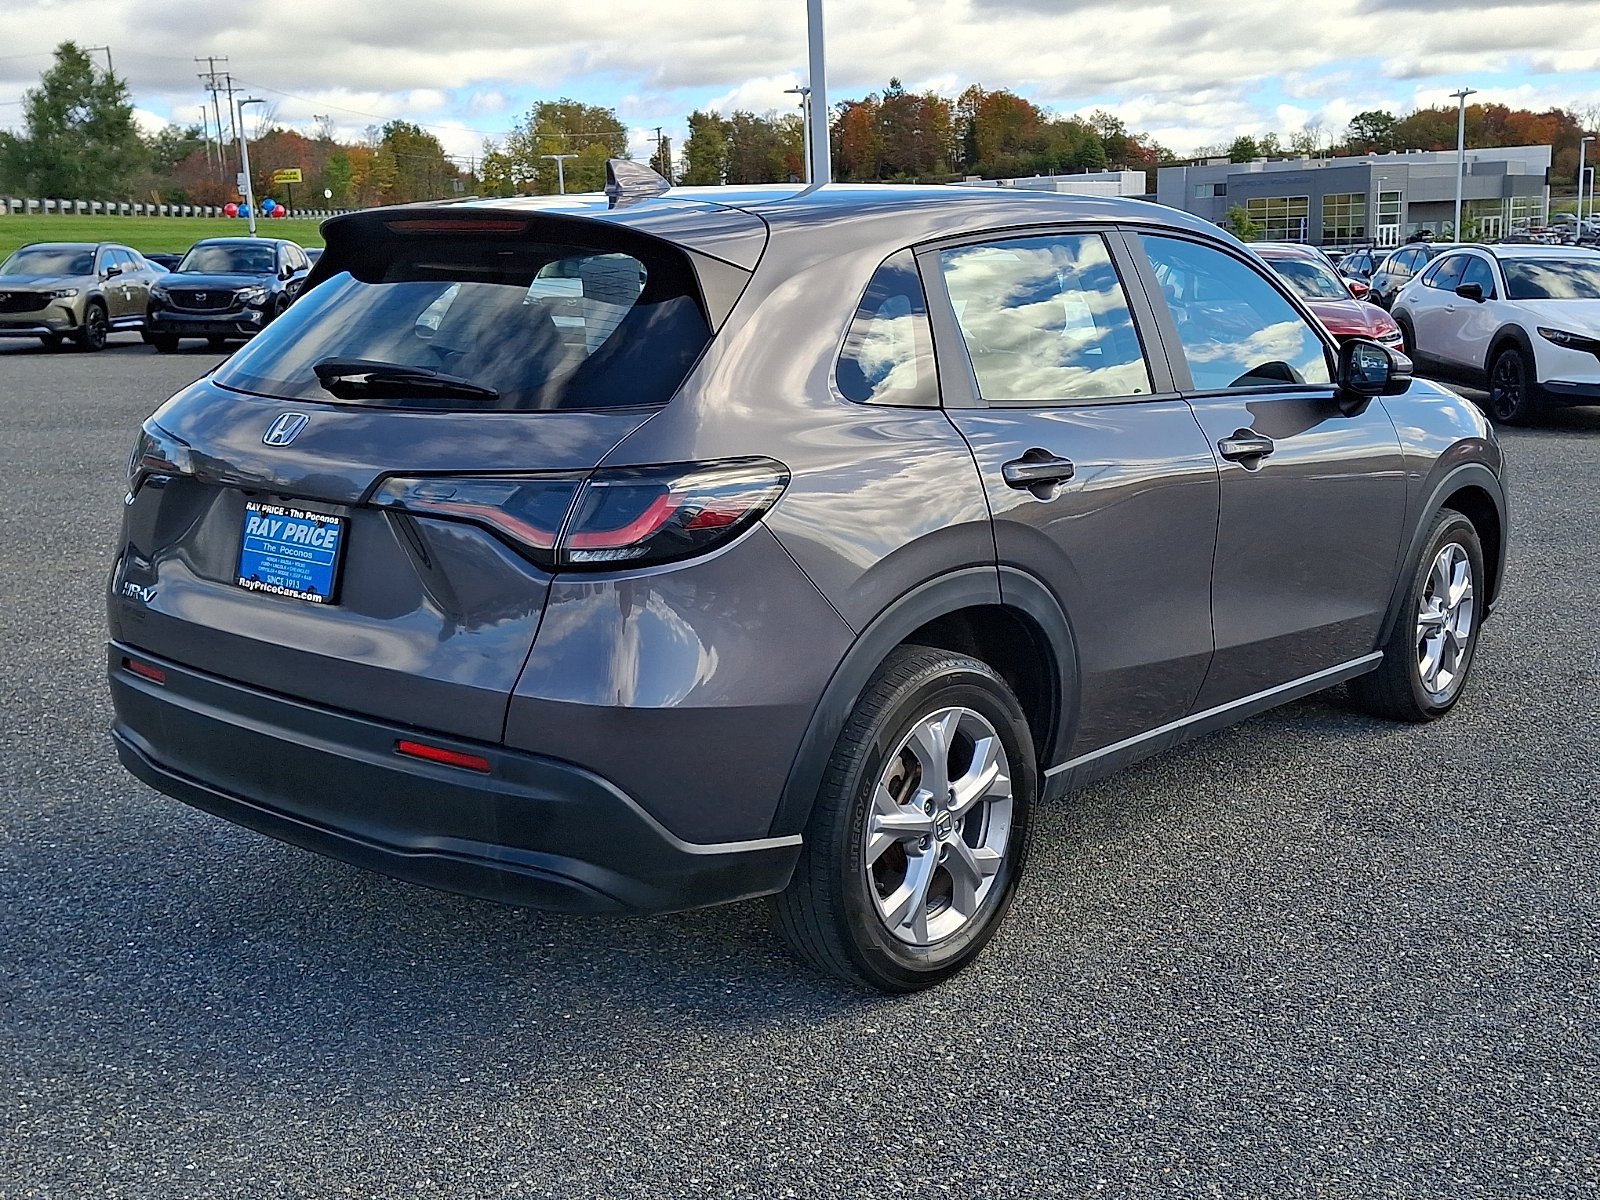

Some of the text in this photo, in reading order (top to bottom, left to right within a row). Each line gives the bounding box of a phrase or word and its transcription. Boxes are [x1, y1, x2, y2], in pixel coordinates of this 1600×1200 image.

[246, 502, 261, 512] RAY
[262, 504, 284, 515] PRICE
[290, 509, 304, 519] The
[305, 512, 339, 524] Poconos
[246, 517, 339, 549] RAY PRICE
[263, 543, 313, 559] The Poconos
[238, 578, 322, 603] RayPriceCars.com
[267, 575, 300, 589] SINCE 1913
